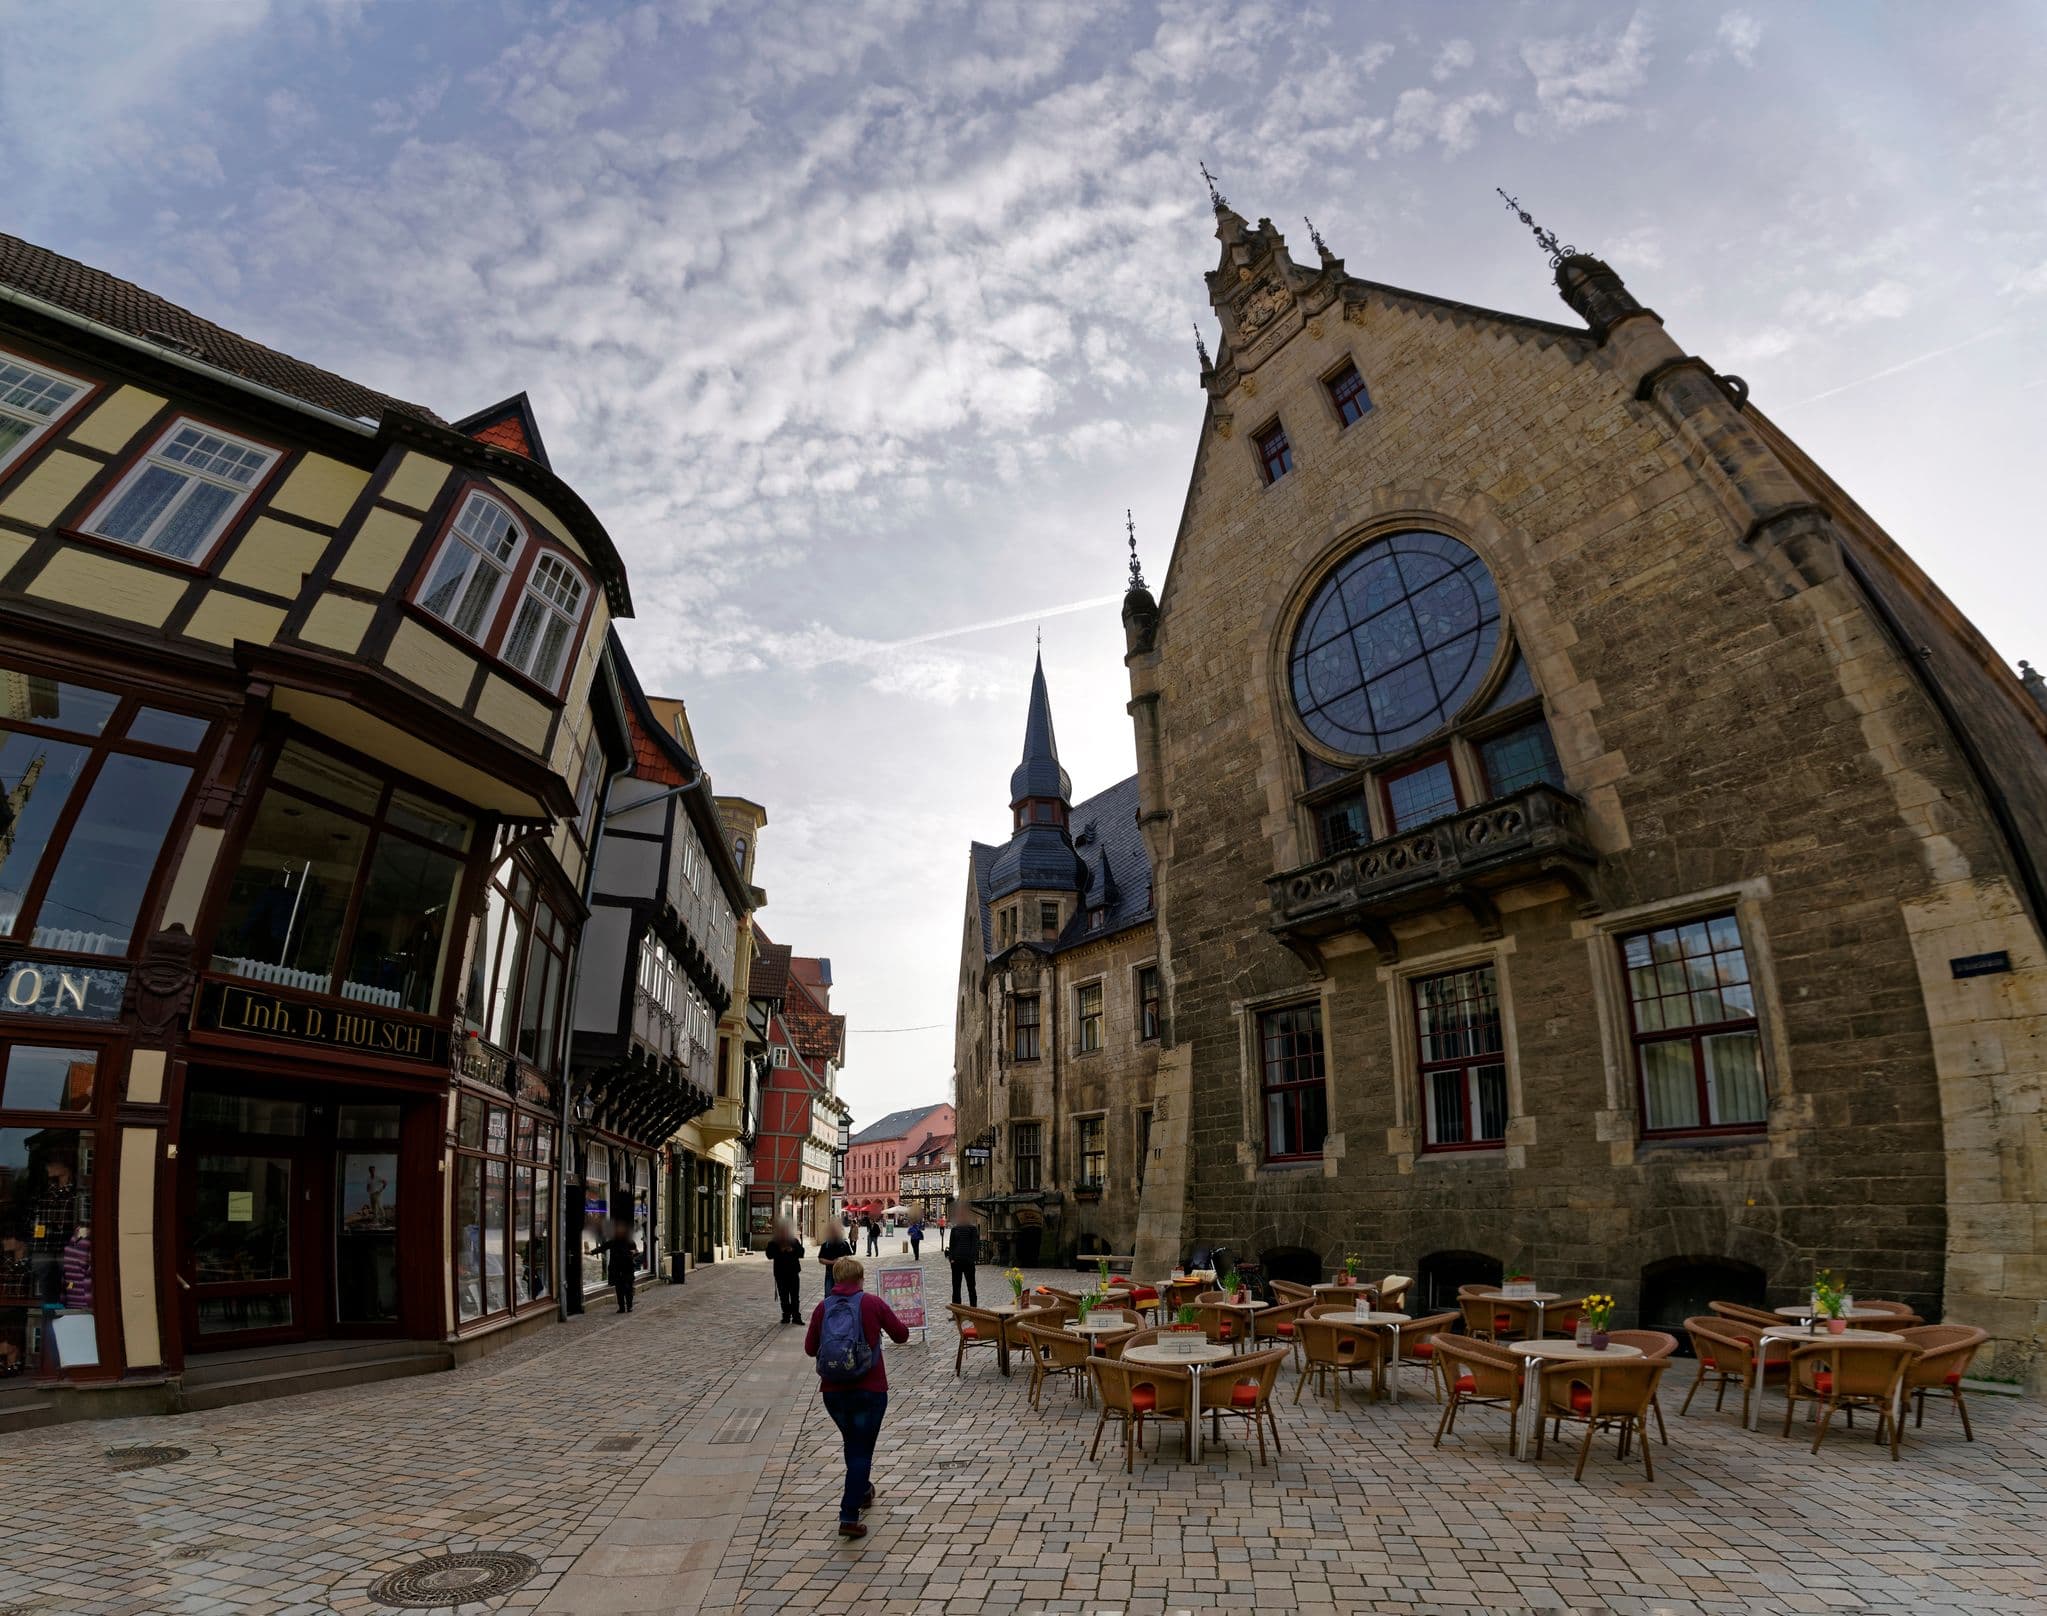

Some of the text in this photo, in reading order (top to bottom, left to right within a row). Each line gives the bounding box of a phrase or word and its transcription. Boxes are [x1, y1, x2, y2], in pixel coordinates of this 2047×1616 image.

[8, 968, 91, 1011] ON
[241, 996, 420, 1054] Inh. D. HULSCH
